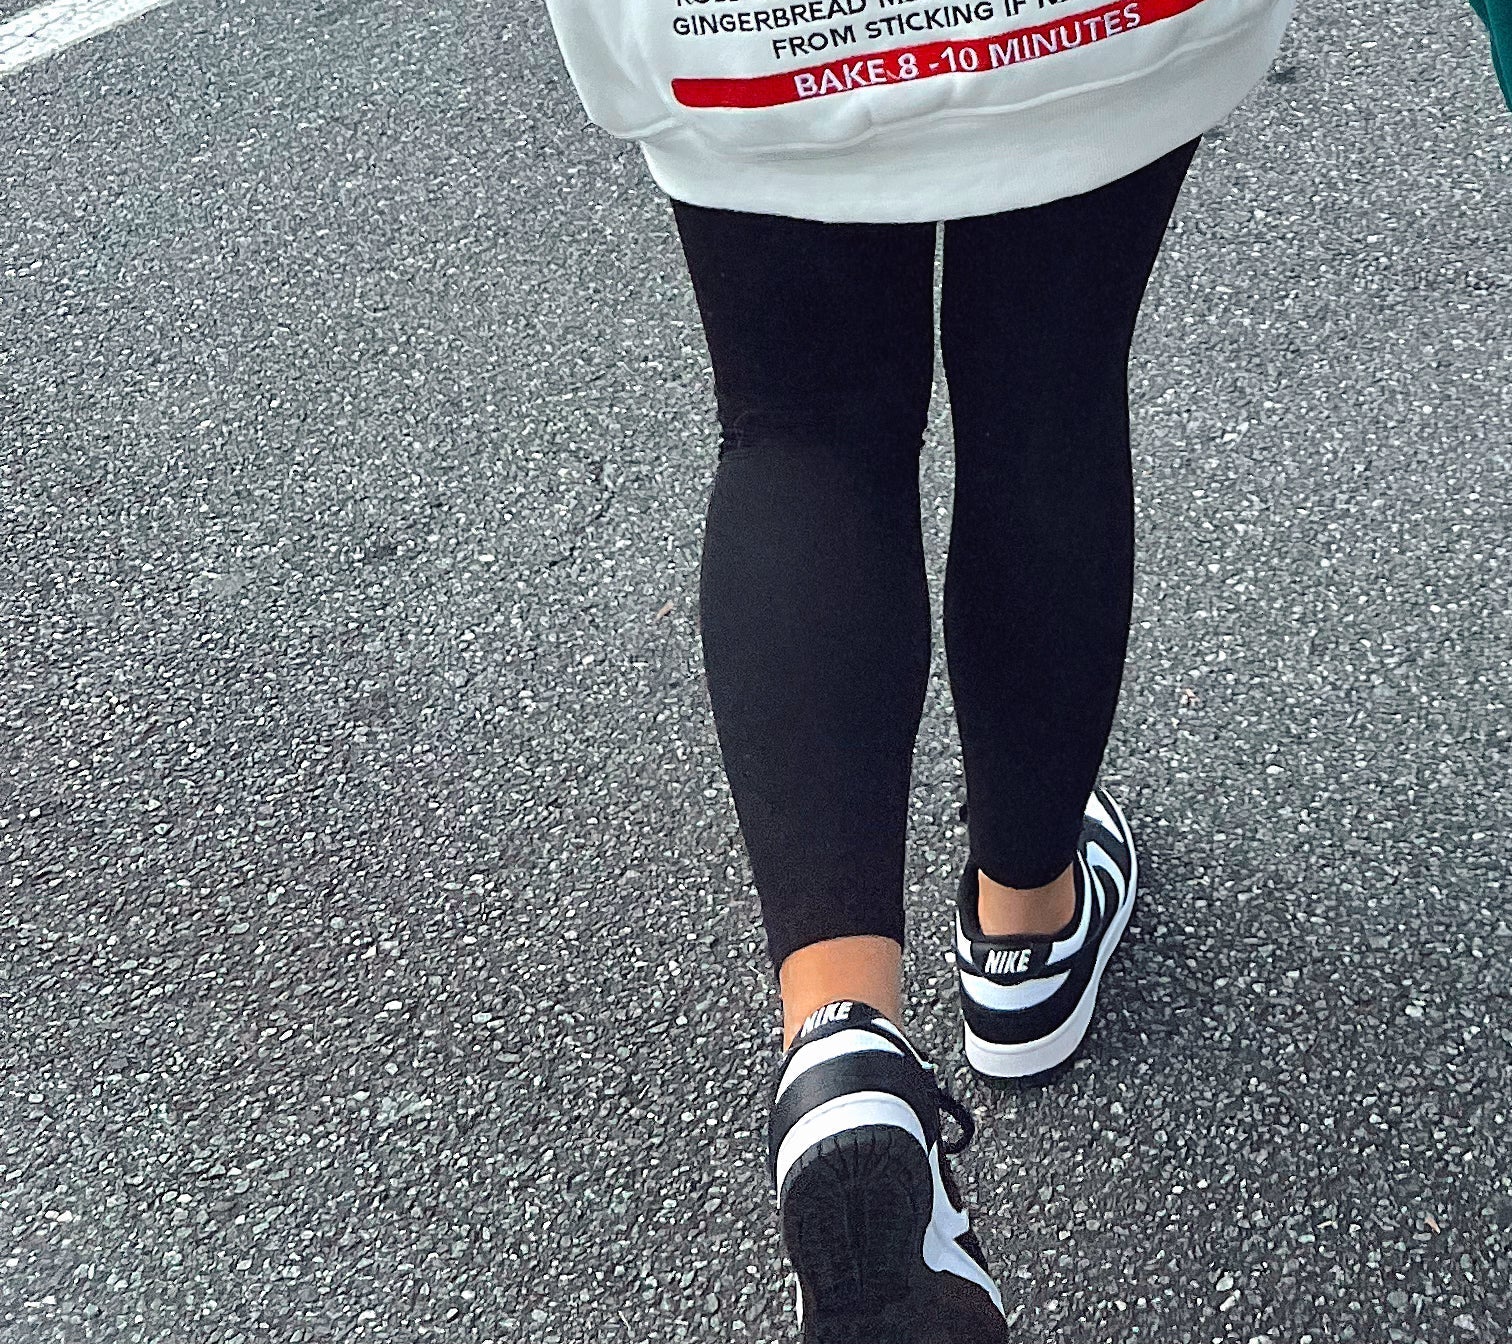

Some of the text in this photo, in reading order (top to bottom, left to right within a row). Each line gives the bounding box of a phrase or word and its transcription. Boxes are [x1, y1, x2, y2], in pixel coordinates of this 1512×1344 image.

[772, 24, 857, 60] FROM
[865, 0, 994, 40] STICKING
[794, 58, 889, 99] BAKE
[899, 52, 921, 80] 8
[989, 2, 1141, 69] MINUTES
[985, 949, 1032, 975] NIKE
[800, 1001, 853, 1038] NIKE
